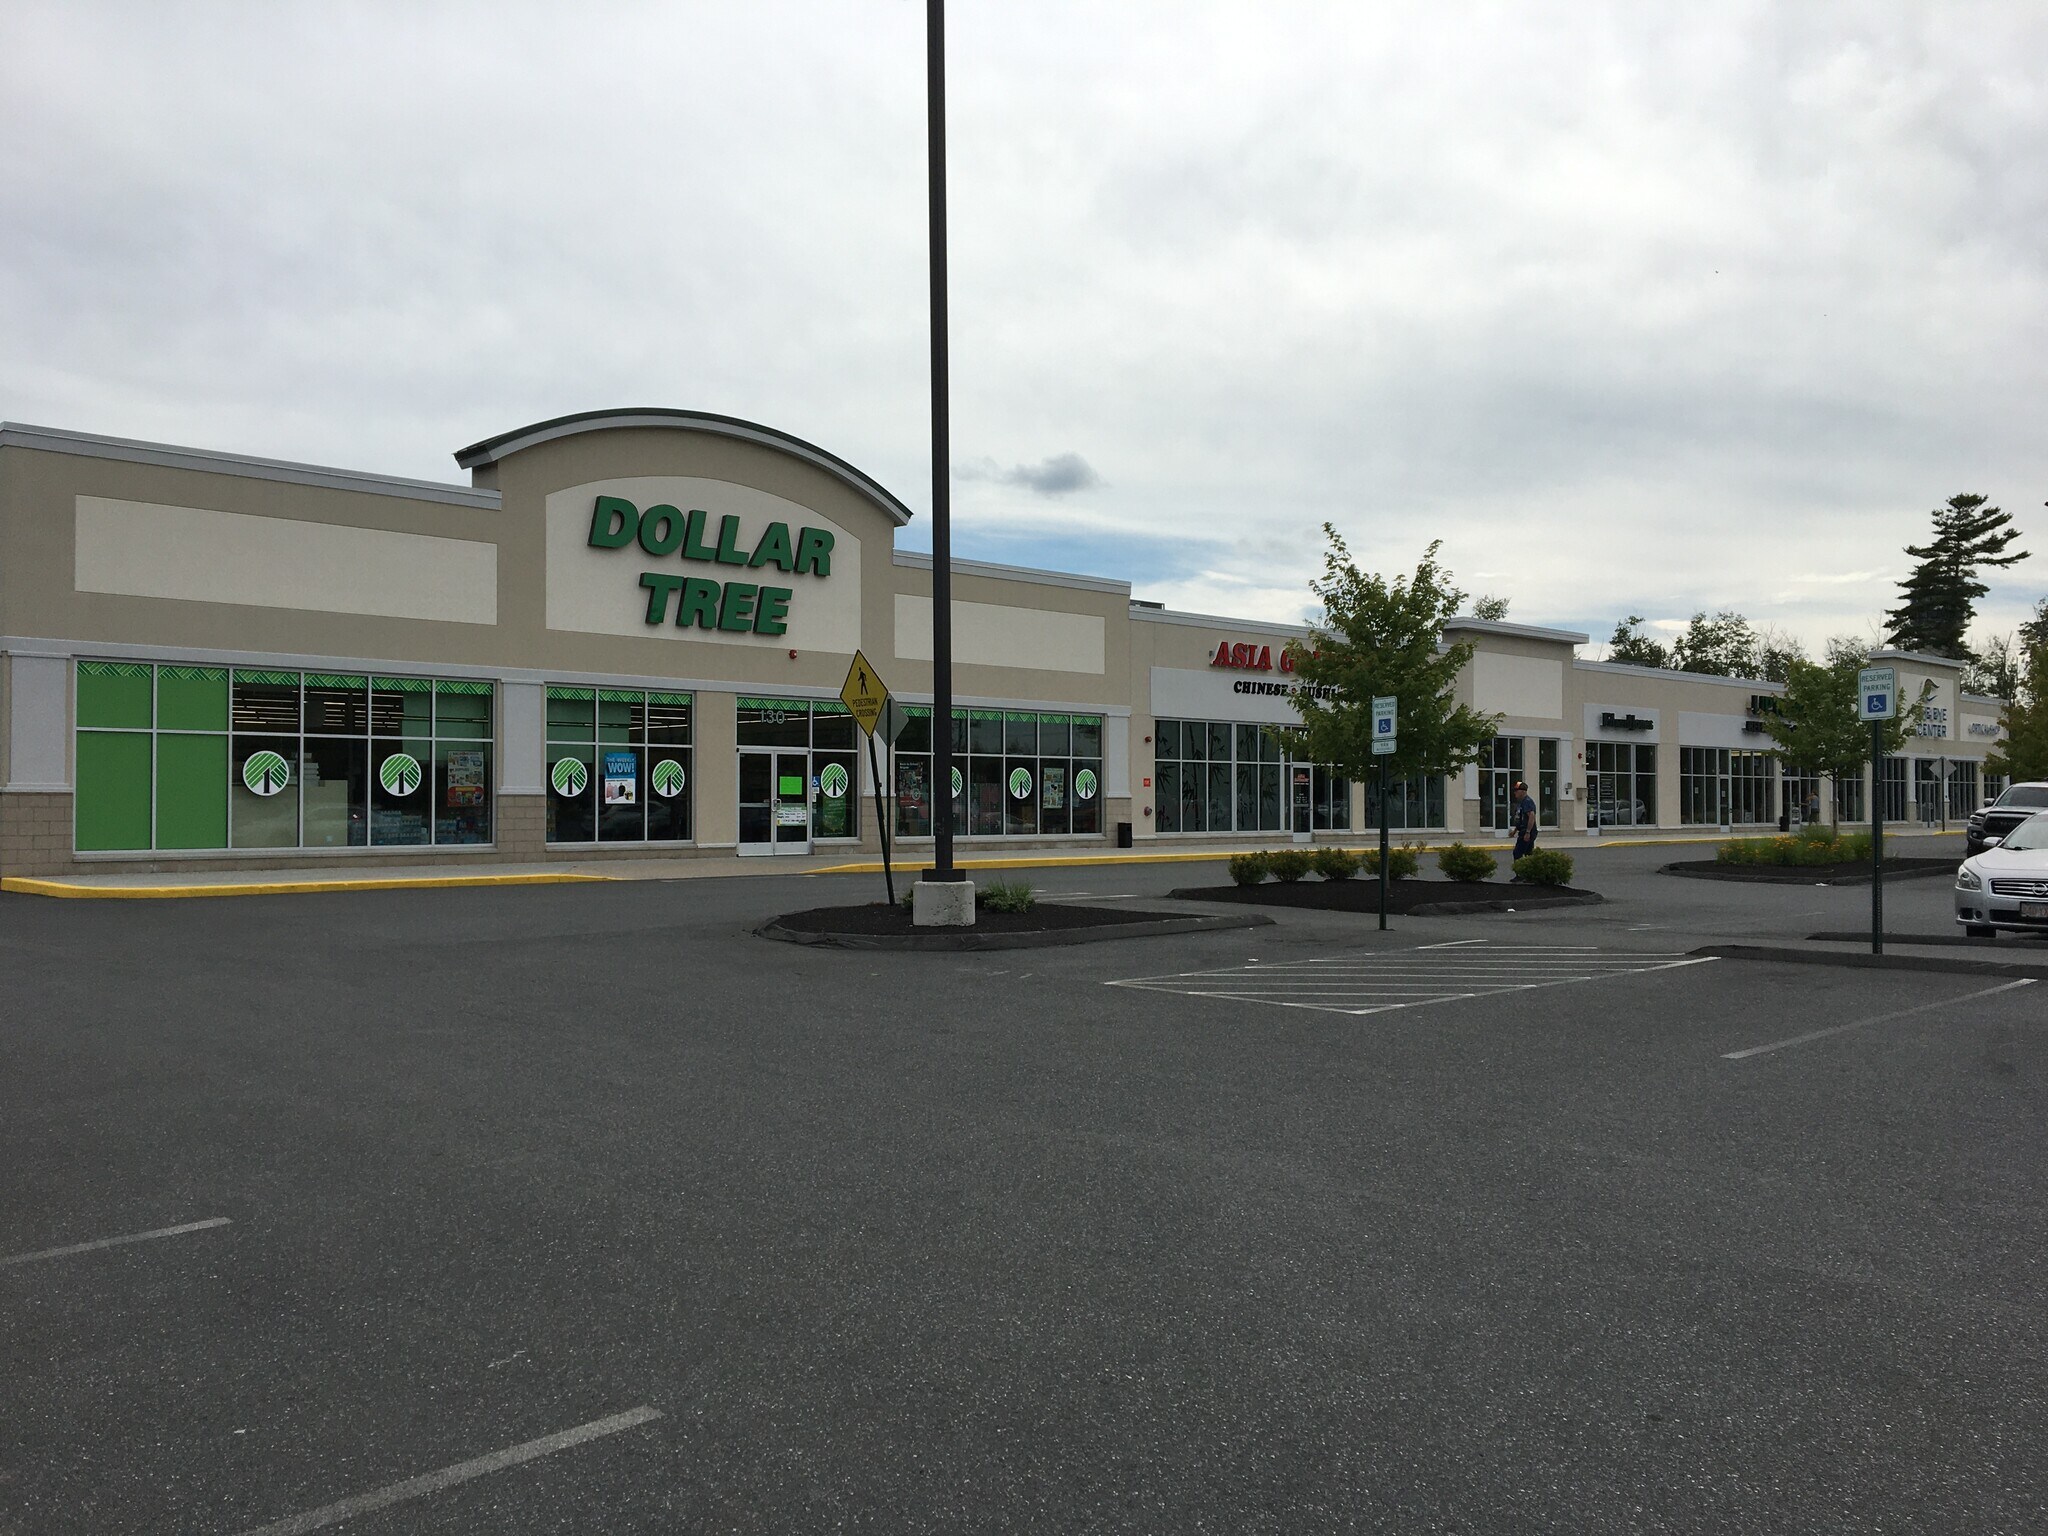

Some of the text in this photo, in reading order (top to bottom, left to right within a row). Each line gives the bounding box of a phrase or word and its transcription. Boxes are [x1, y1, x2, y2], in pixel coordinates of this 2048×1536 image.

[587, 495, 835, 577] DOLLAR
[639, 572, 793, 635] TREE
[1210, 641, 1273, 671] ASIA
[1861, 673, 1893, 682] RESERVED
[1233, 680, 1288, 697] CHINESE
[1863, 683, 1891, 692] PARKING
[852, 698, 878, 707] PEDESTRIAN
[760, 710, 785, 725] 130
[856, 708, 877, 717] CROSSING
[1917, 723, 1947, 737] CENTER
[607, 762, 635, 773] WOW!
